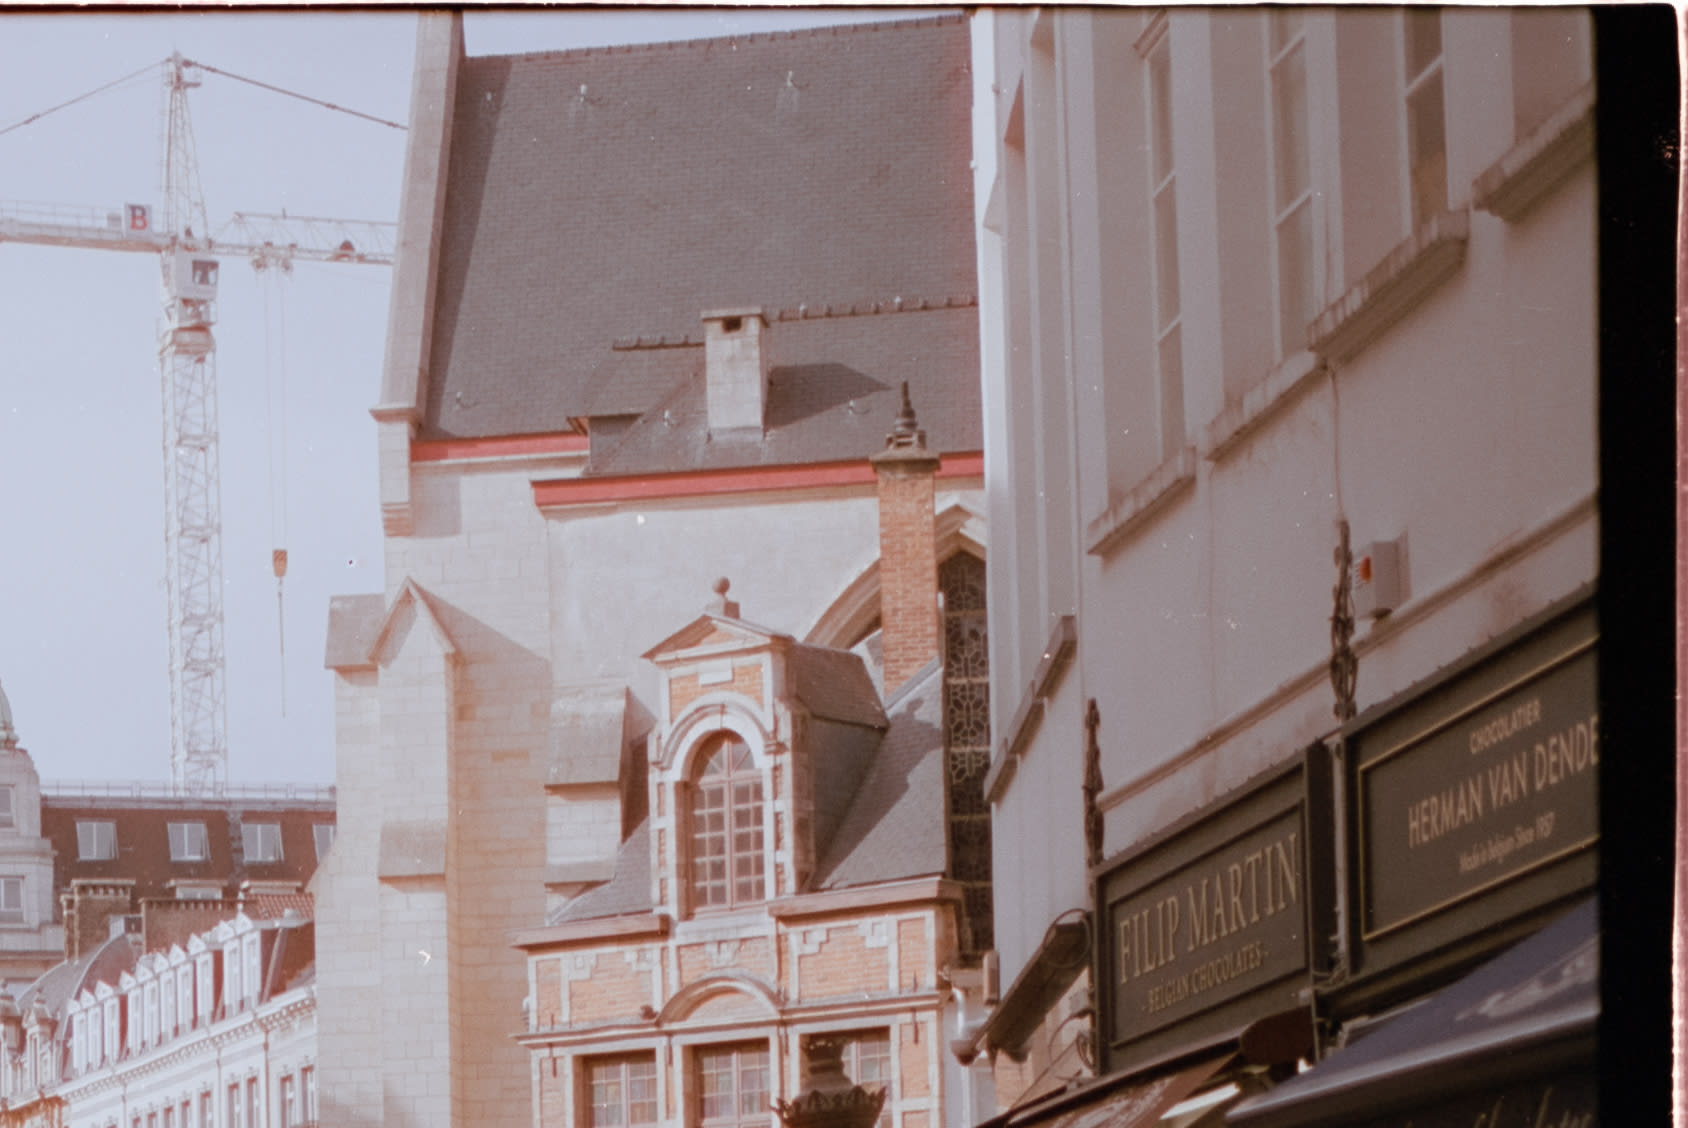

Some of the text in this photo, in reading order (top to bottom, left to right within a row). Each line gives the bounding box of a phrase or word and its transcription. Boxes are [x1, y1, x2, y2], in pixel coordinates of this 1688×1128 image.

[1469, 699, 1541, 755] CHOCOLATIER
[1408, 773, 1484, 849] HERMAN
[1488, 751, 1529, 810] VAN
[1120, 832, 1297, 985] FILIP MARTIN
[1148, 940, 1263, 1014] BELGIAN CHOCOLATES
